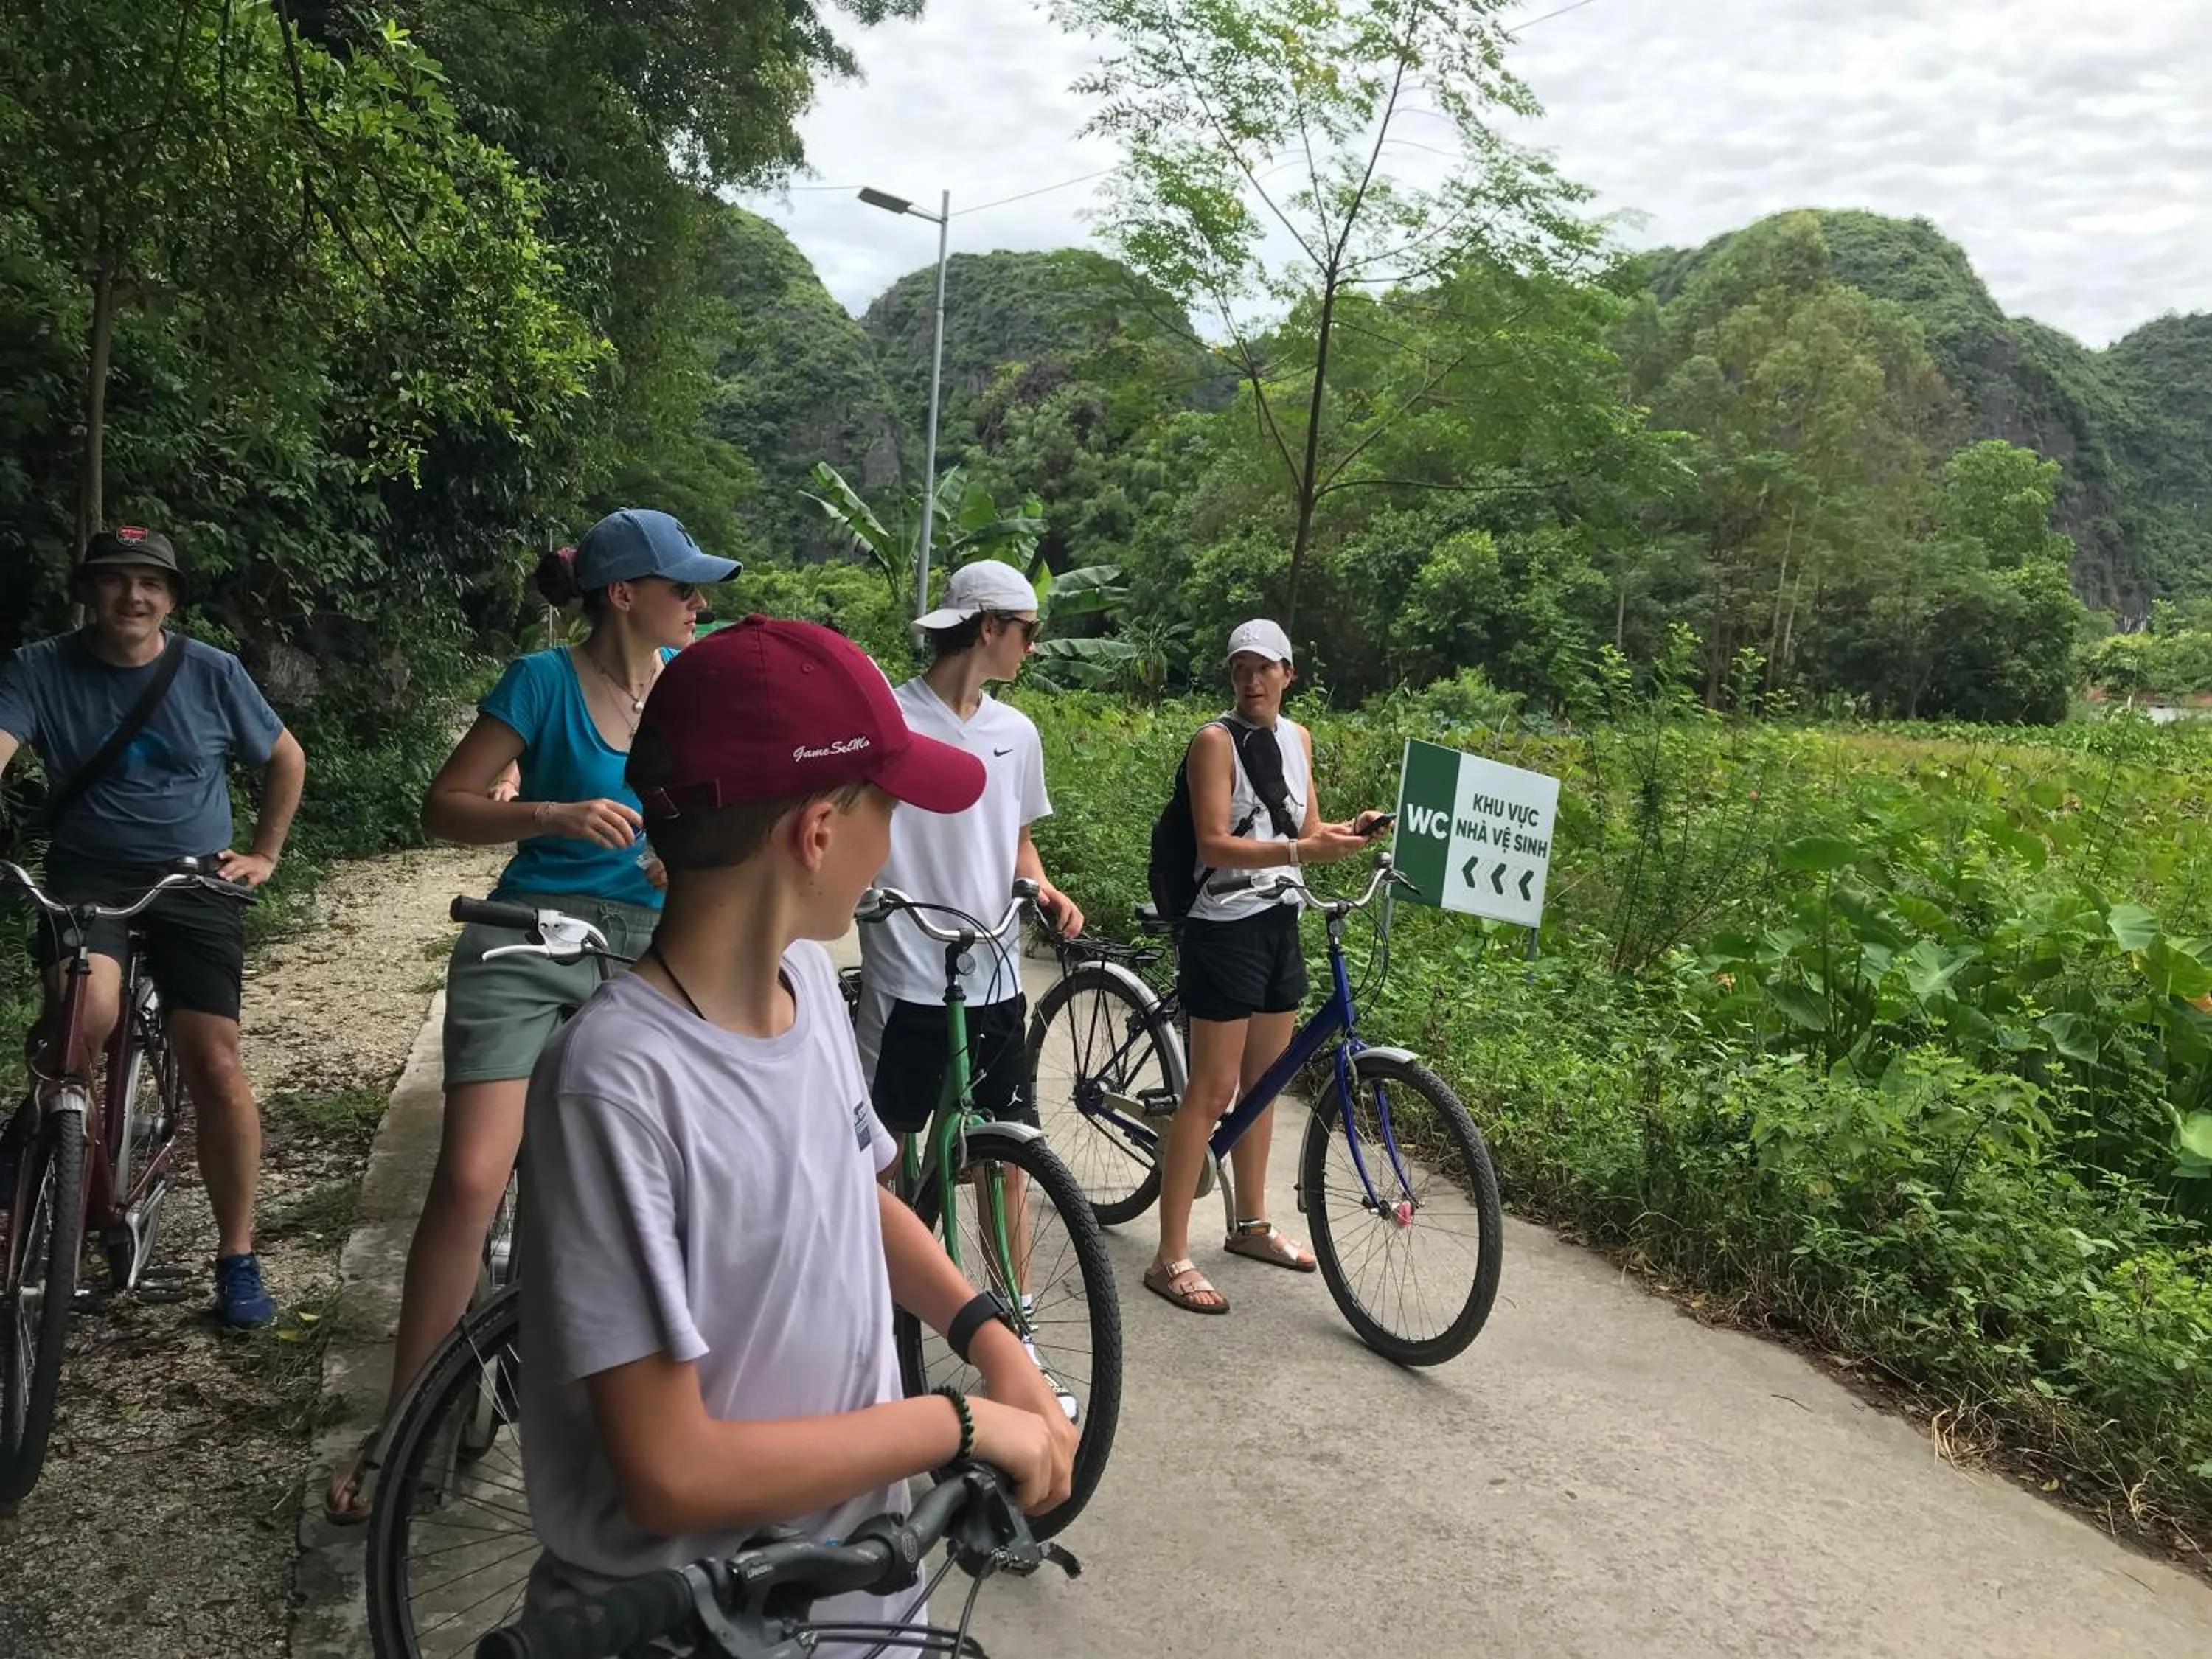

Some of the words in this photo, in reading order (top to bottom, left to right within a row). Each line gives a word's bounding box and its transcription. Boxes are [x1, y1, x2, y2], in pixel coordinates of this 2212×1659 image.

[1407, 803, 1449, 839] WC
[1473, 793, 1505, 818] KHU
[1509, 803, 1540, 829] VỰC
[1455, 818, 1487, 844] NHÀ
[1492, 826, 1511, 853] VỆ
[1513, 834, 1548, 859] SINH
